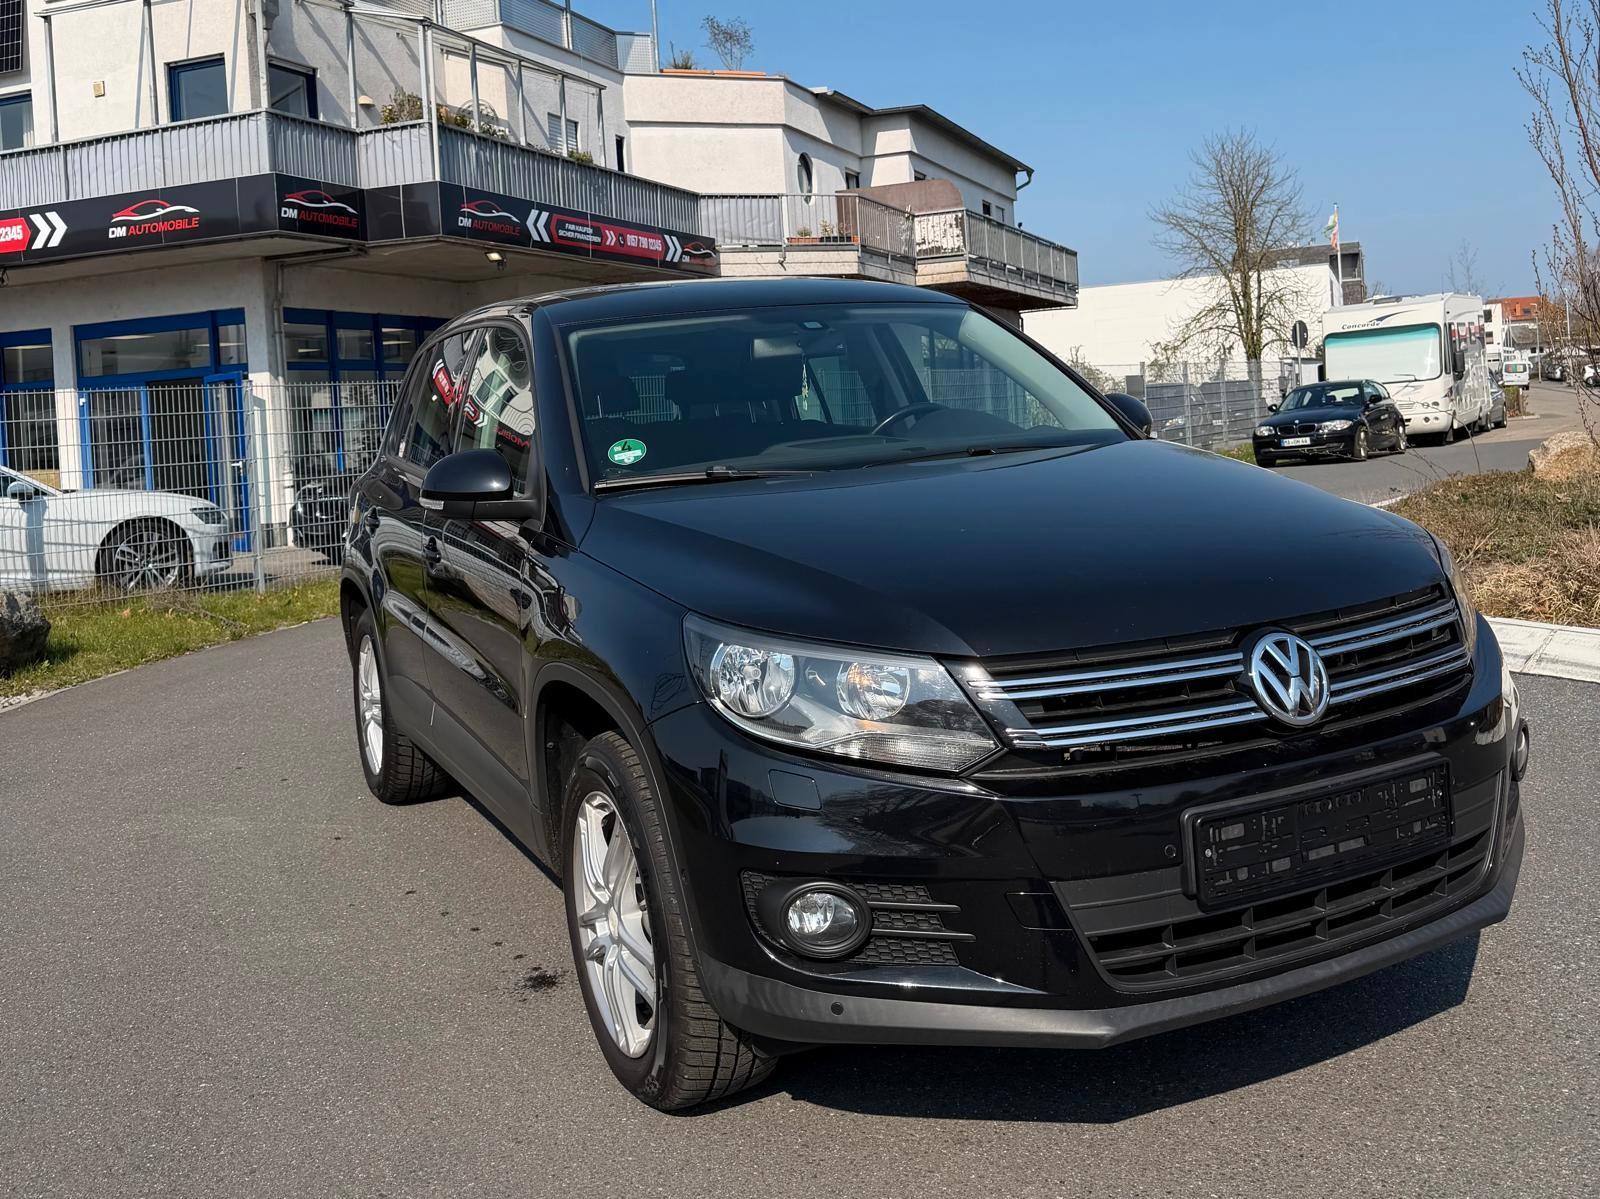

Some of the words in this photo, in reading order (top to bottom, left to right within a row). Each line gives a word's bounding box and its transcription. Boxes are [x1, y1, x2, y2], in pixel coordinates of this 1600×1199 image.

[108, 226, 127, 238] DM
[128, 217, 200, 235] AUTOMOBILE
[281, 207, 298, 219] DM
[299, 210, 358, 228] AUTOMOBILE
[458, 216, 472, 228] DM
[472, 219, 520, 236] AUTOMOBILE
[1341, 321, 1381, 330] Concorde
[621, 440, 633, 451] 4
[1253, 633, 1328, 726] VW
